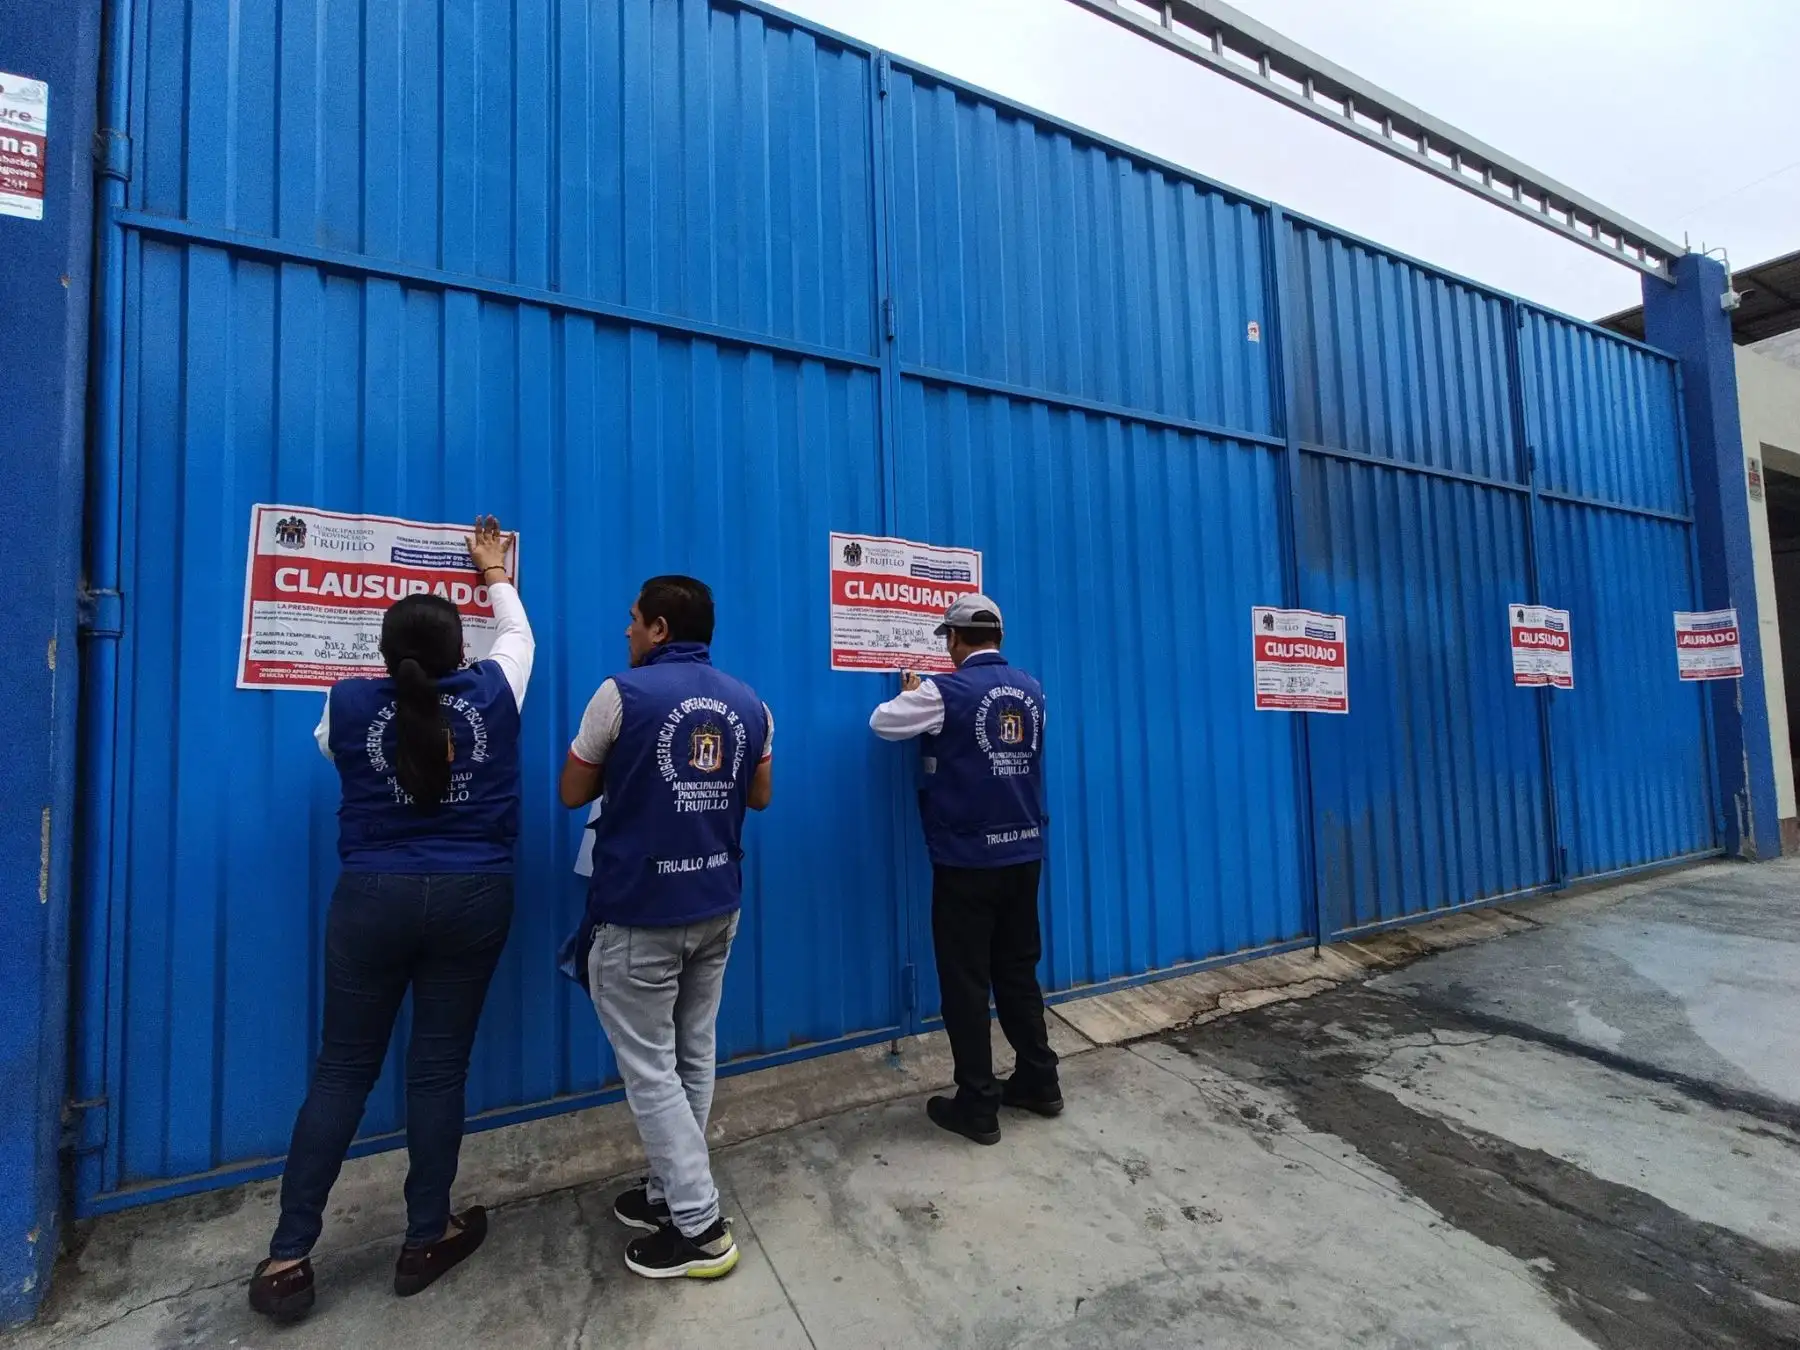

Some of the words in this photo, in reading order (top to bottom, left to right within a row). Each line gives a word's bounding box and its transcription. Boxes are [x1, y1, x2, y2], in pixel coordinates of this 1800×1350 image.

[0, 108, 32, 122] ure
[0, 135, 38, 157] ma
[311, 534, 375, 552] TRUJILLO
[274, 567, 491, 607] CLAUSURADO
[844, 580, 974, 609] CLAUSURAD
[288, 604, 322, 613] PRESENTE
[324, 607, 348, 615] ORDEN
[349, 608, 380, 616] MUNICIPAL
[354, 633, 381, 643] TREIN
[982, 695, 993, 708] DE
[989, 686, 1025, 701] OPERACIONES
[680, 697, 728, 715] OPERACIONES
[668, 708, 685, 724] DE
[727, 711, 739, 725] DE
[453, 698, 469, 712] DE
[464, 707, 490, 763] FISCALIZACIÓN
[976, 706, 993, 753] SUBGERENCIA
[366, 720, 388, 772] SUBGERENCIA
[378, 707, 395, 720] DE
[656, 722, 678, 782] SUBGERENCIA
[731, 723, 747, 780] FISCALIZAC
[990, 765, 1030, 776] TRUJILLO
[672, 781, 734, 791] MUNICIPALIDAD
[678, 790, 720, 800] PROVINCIAL
[674, 799, 729, 813] TRUJILLO
[986, 830, 1018, 846] TRUJILLO
[656, 857, 704, 875] TRUJILLO
